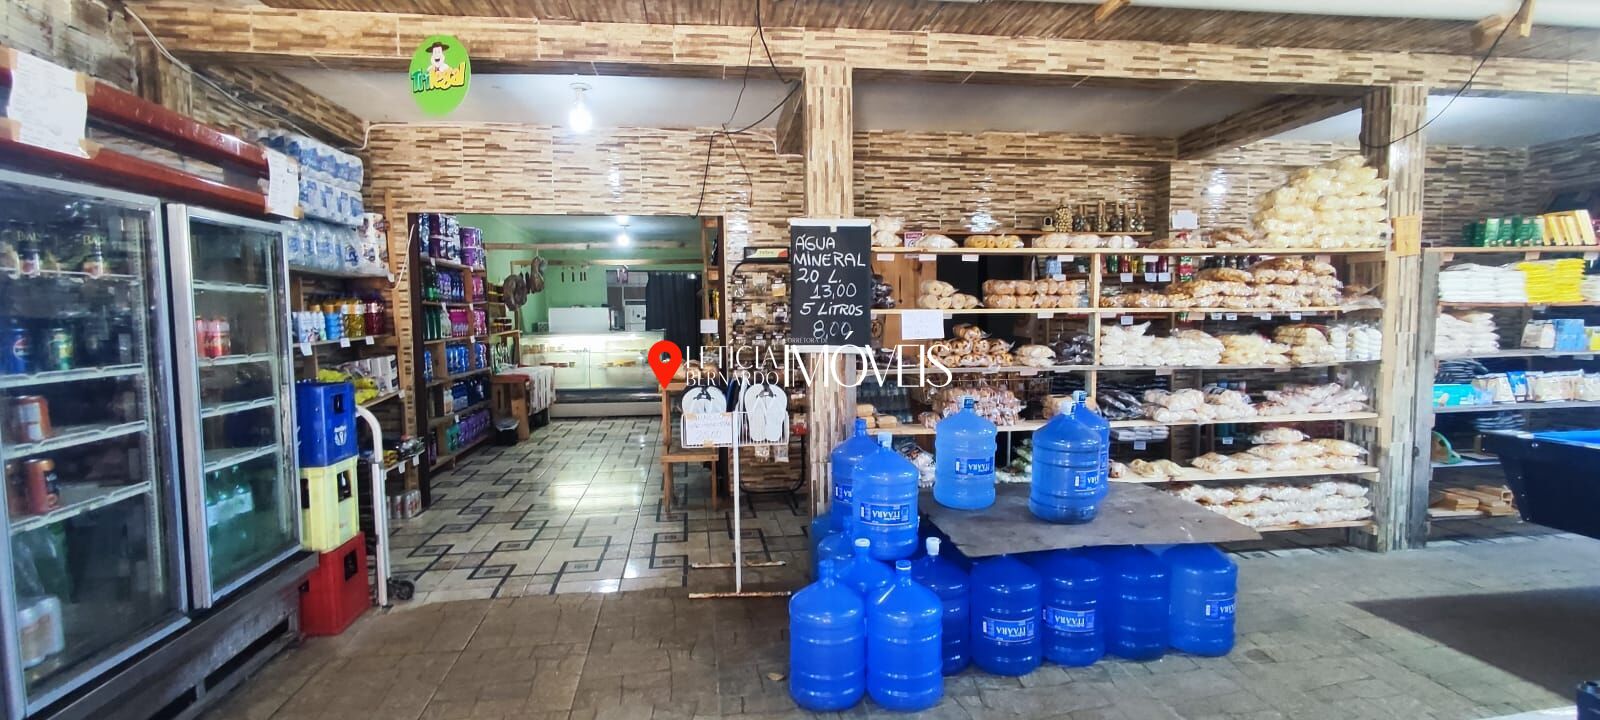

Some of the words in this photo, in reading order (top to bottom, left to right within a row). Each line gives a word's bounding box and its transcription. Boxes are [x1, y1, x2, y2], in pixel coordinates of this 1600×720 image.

[795, 234, 836, 251] ÁGUA
[793, 251, 866, 268] MINERAL
[797, 268, 820, 284] 20
[810, 282, 857, 300] 13,00
[800, 302, 816, 315] 5
[817, 301, 864, 316] LITROS
[813, 319, 852, 340] 8,00
